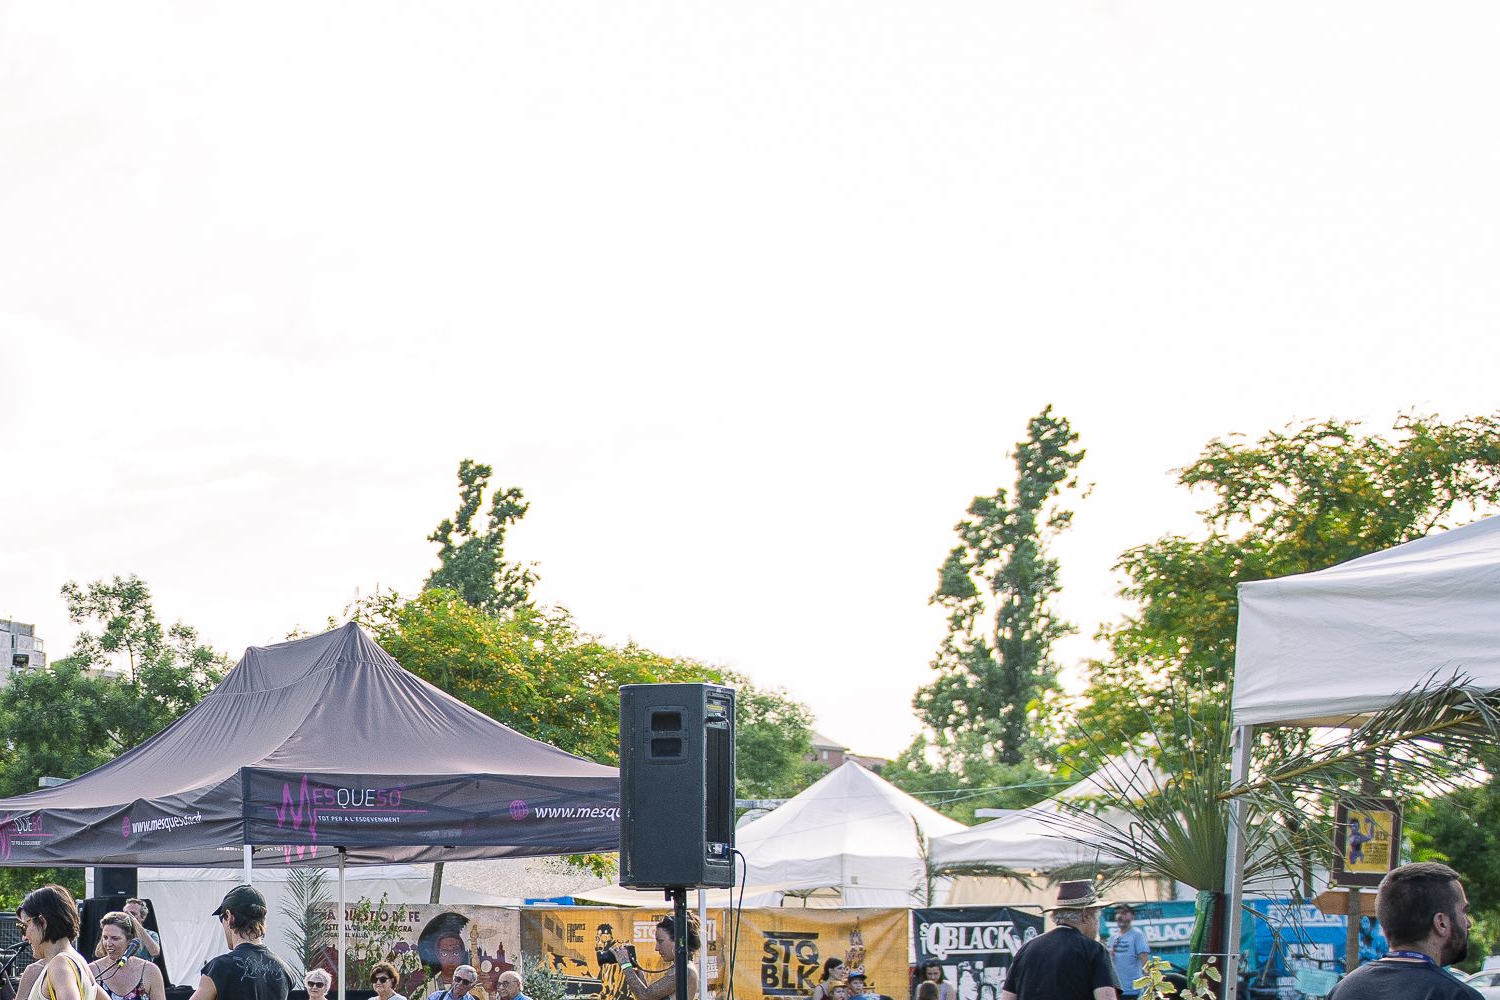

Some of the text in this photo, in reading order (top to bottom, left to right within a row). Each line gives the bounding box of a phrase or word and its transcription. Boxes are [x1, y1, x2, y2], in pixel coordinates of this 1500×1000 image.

[408, 910, 420, 922] FE
[762, 939, 820, 965] STQ
[761, 964, 820, 989] BLK
